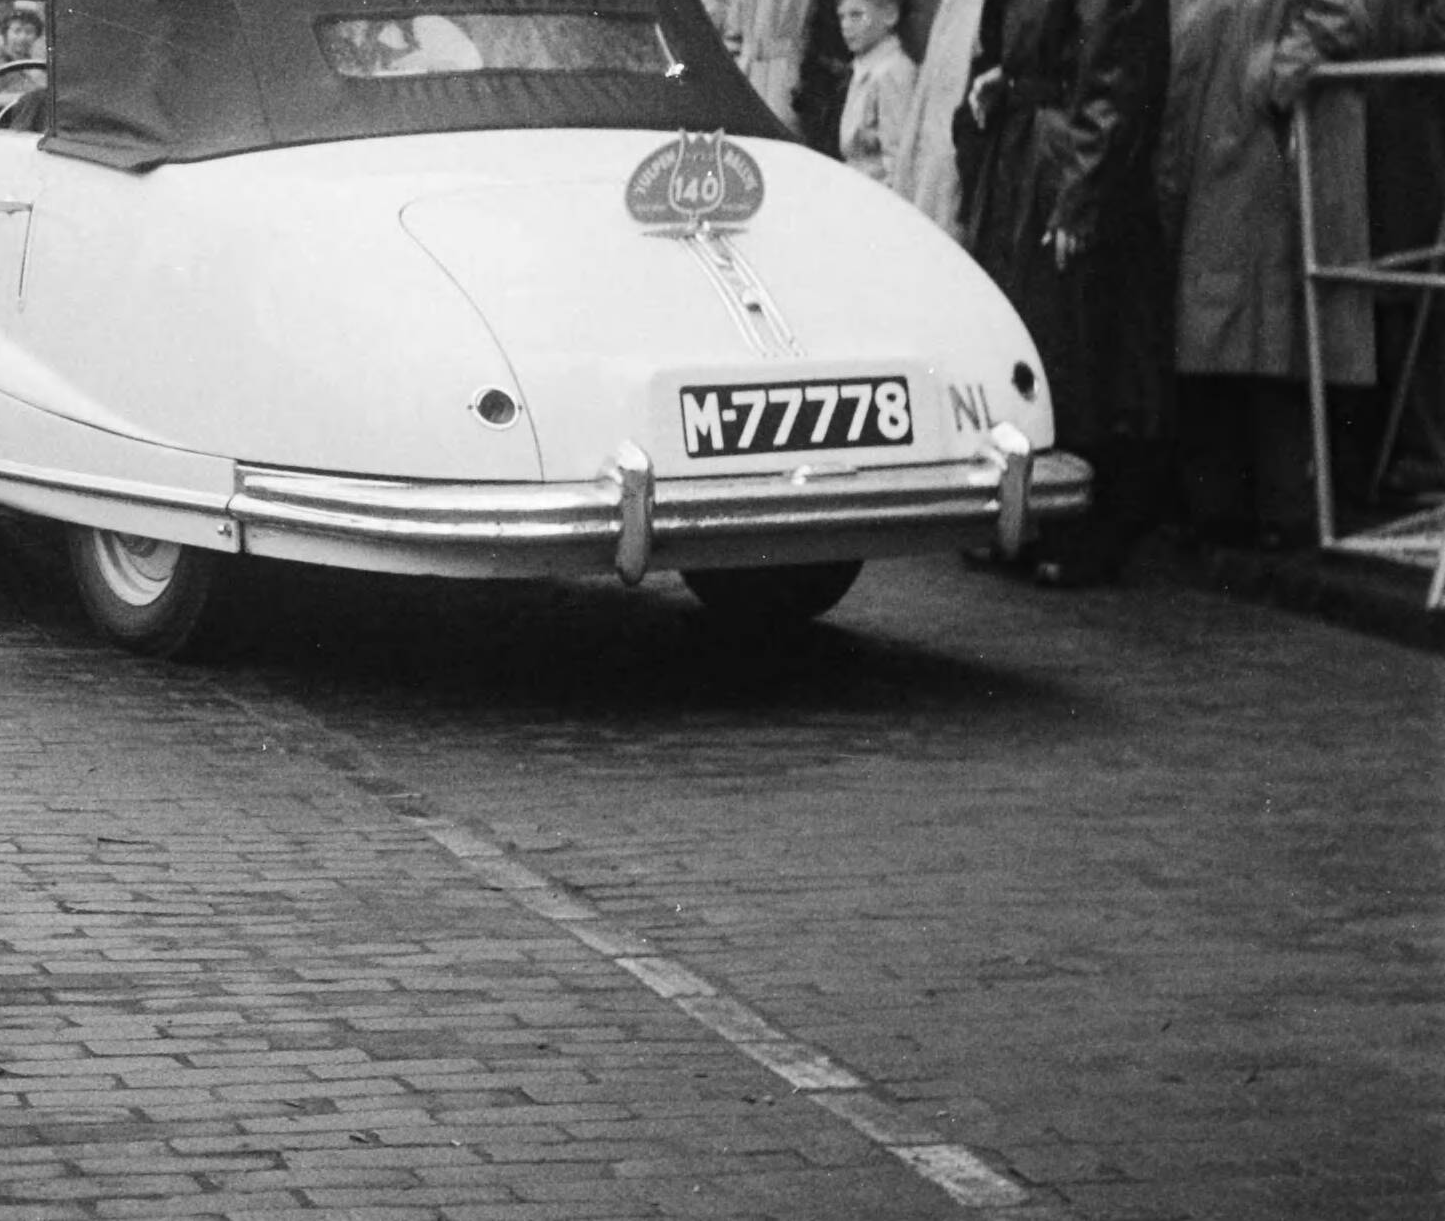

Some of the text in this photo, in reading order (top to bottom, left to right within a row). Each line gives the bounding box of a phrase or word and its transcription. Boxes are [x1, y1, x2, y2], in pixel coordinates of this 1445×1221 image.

[675, 176, 719, 202] 140
[682, 382, 909, 453] M-77778
[949, 383, 995, 433] NL
